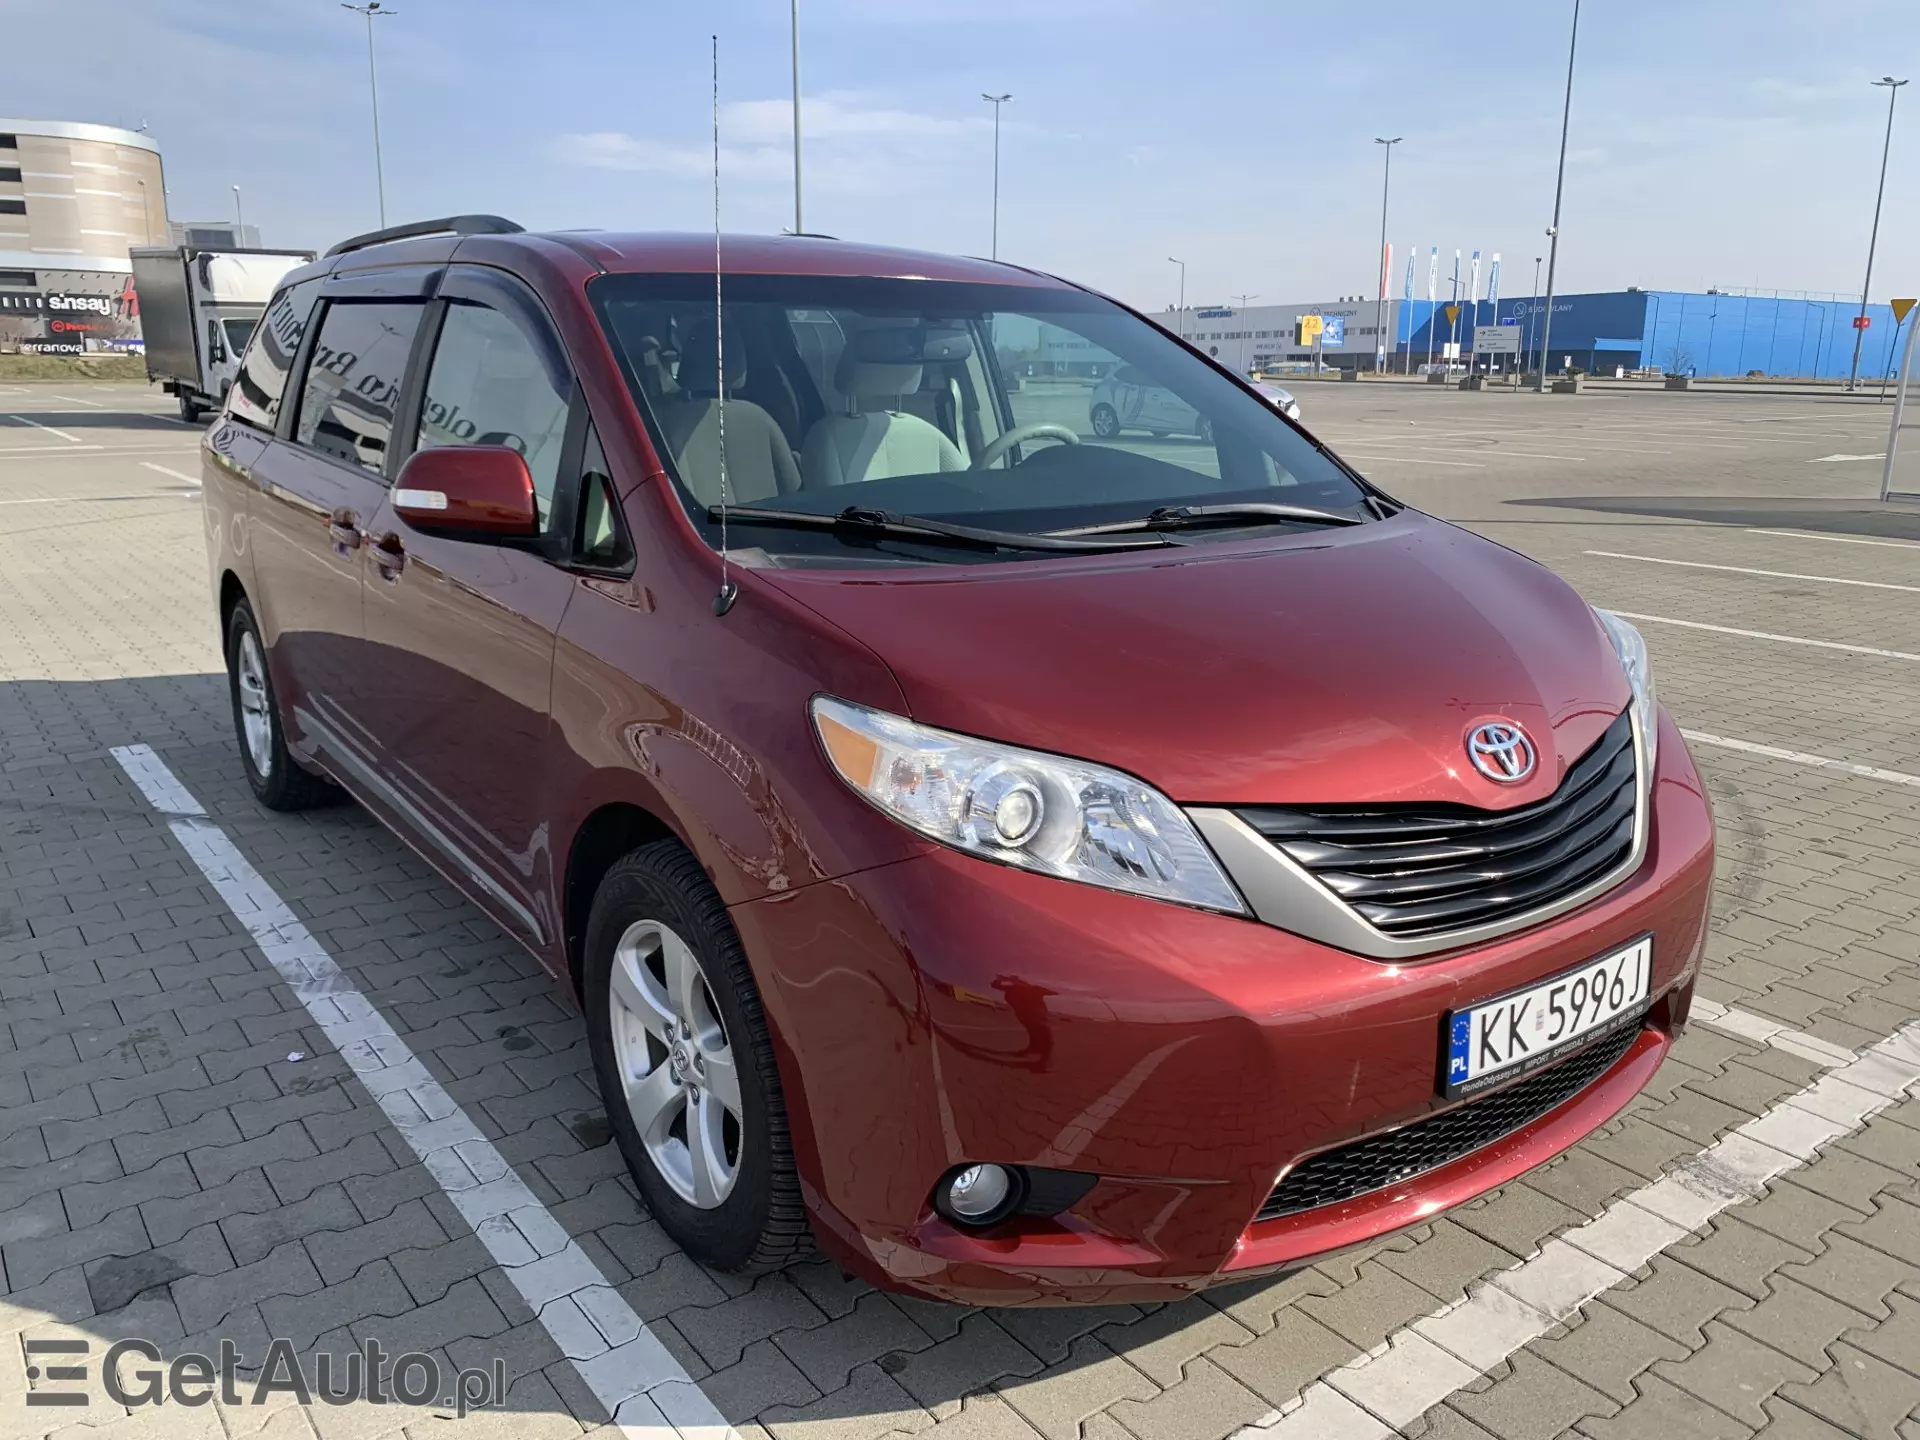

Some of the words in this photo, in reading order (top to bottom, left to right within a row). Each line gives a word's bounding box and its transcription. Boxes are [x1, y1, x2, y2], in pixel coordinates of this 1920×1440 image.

[48, 293, 112, 316] sinsay
[1527, 304, 1574, 313] BUDLANY
[1479, 997, 1532, 1069] KK
[1547, 948, 1642, 1041] 5996J
[1451, 1056, 1467, 1075] PL
